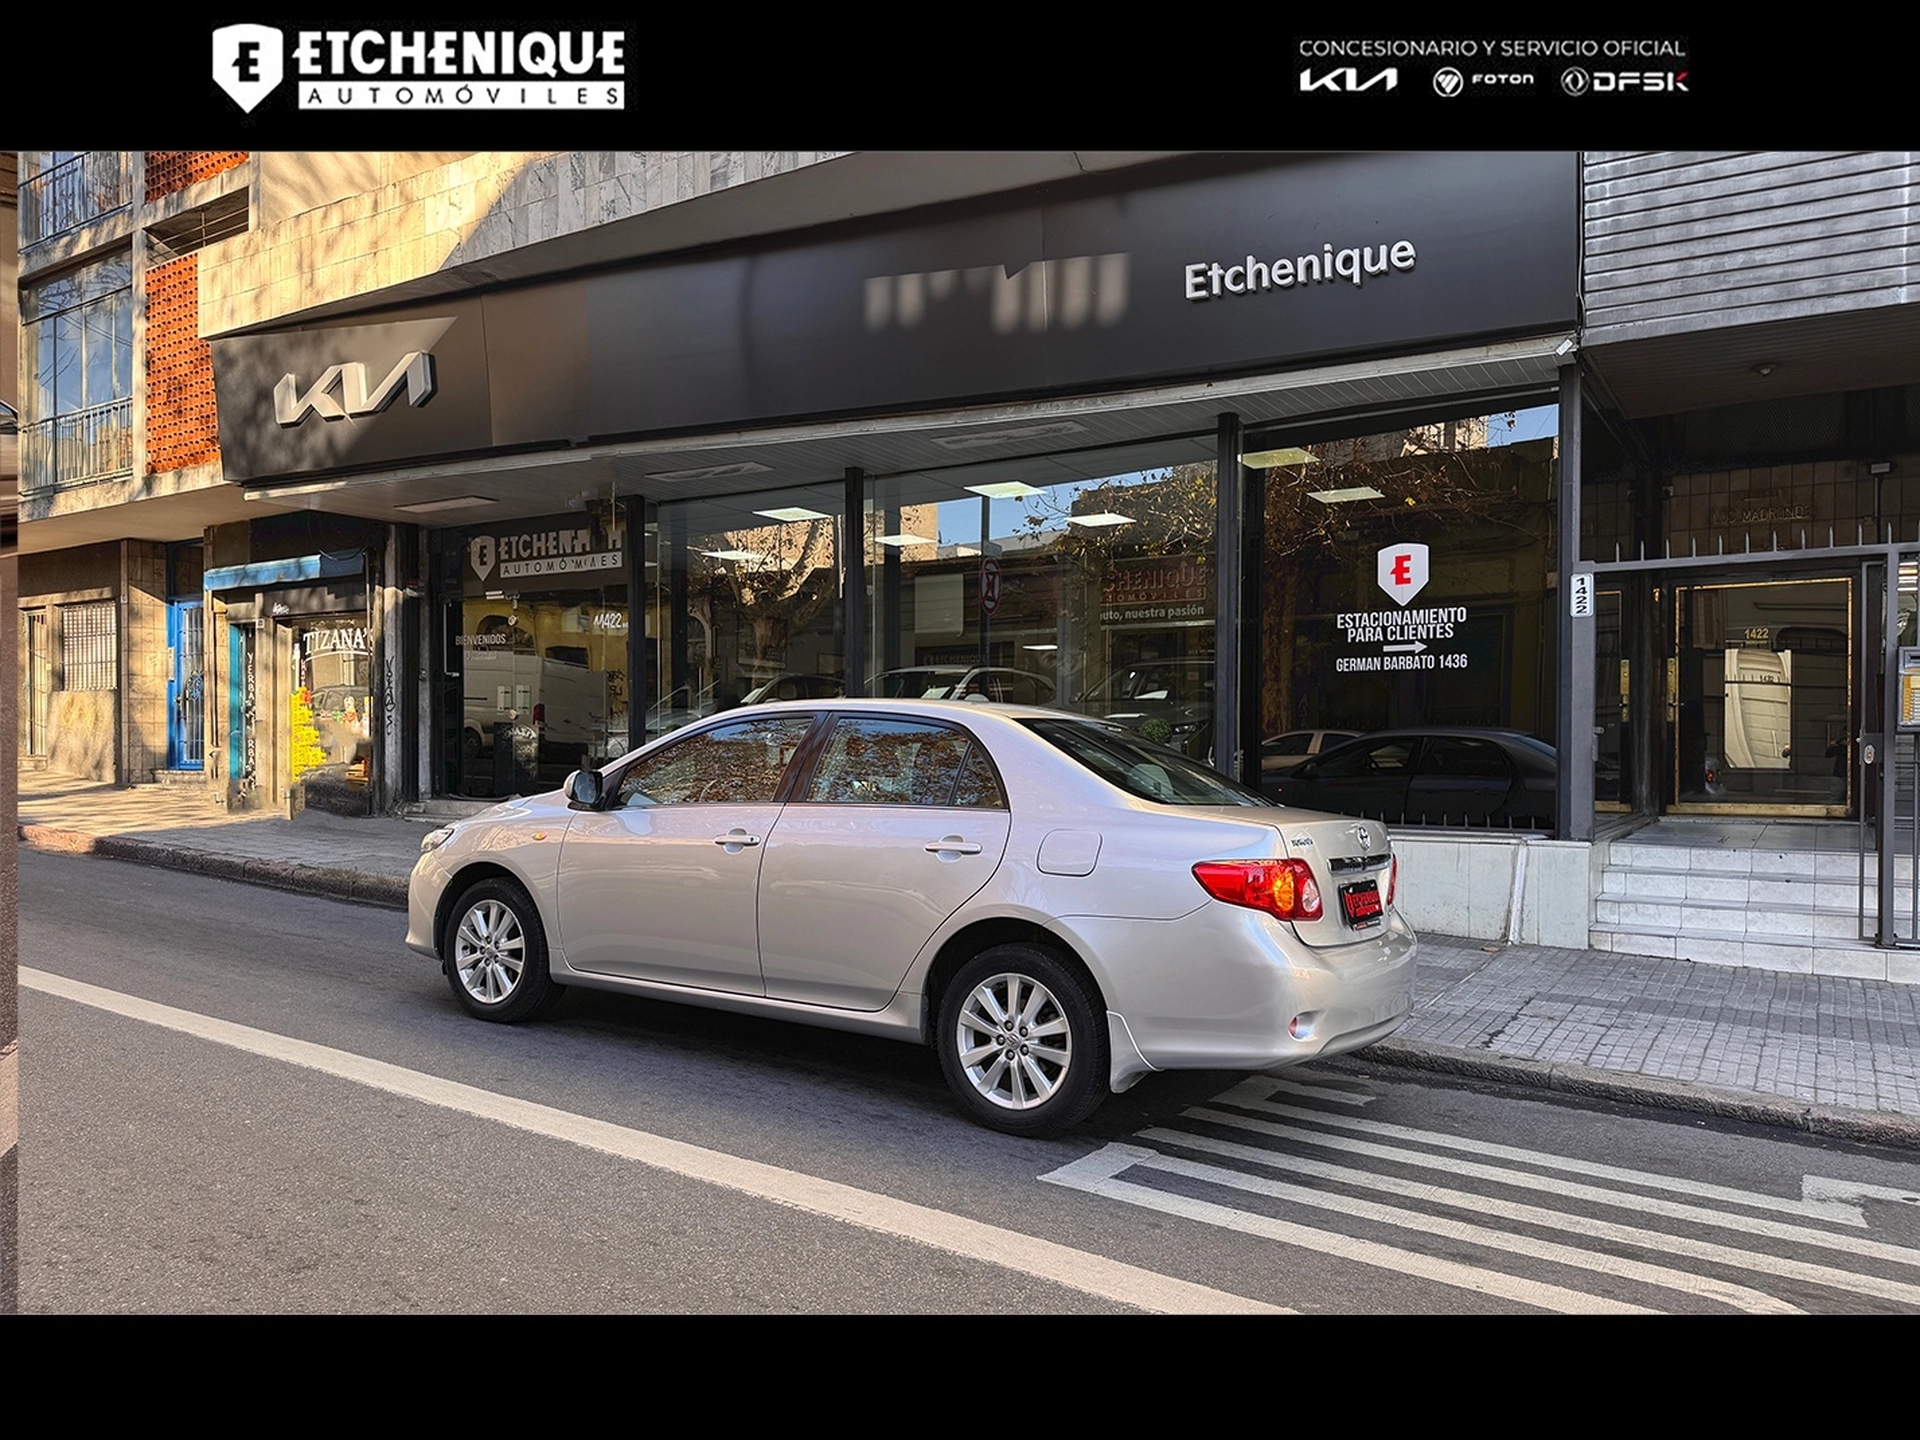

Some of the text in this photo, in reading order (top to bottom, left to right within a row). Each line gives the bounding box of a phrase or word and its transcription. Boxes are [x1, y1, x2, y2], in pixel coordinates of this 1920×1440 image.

[1185, 240, 1416, 299] Etchenique
[1575, 576, 1588, 614] 1422
[1125, 608, 1165, 619] nuestra
[1168, 604, 1204, 619] pasión
[1336, 606, 1467, 629] ESTACIONAMIENTO
[455, 633, 507, 646] BIENVENIDOS
[1347, 623, 1454, 643] PARA CLIENTES
[1744, 628, 1769, 640] 1422
[1336, 654, 1468, 672] GERMAN BARBATO 1436
